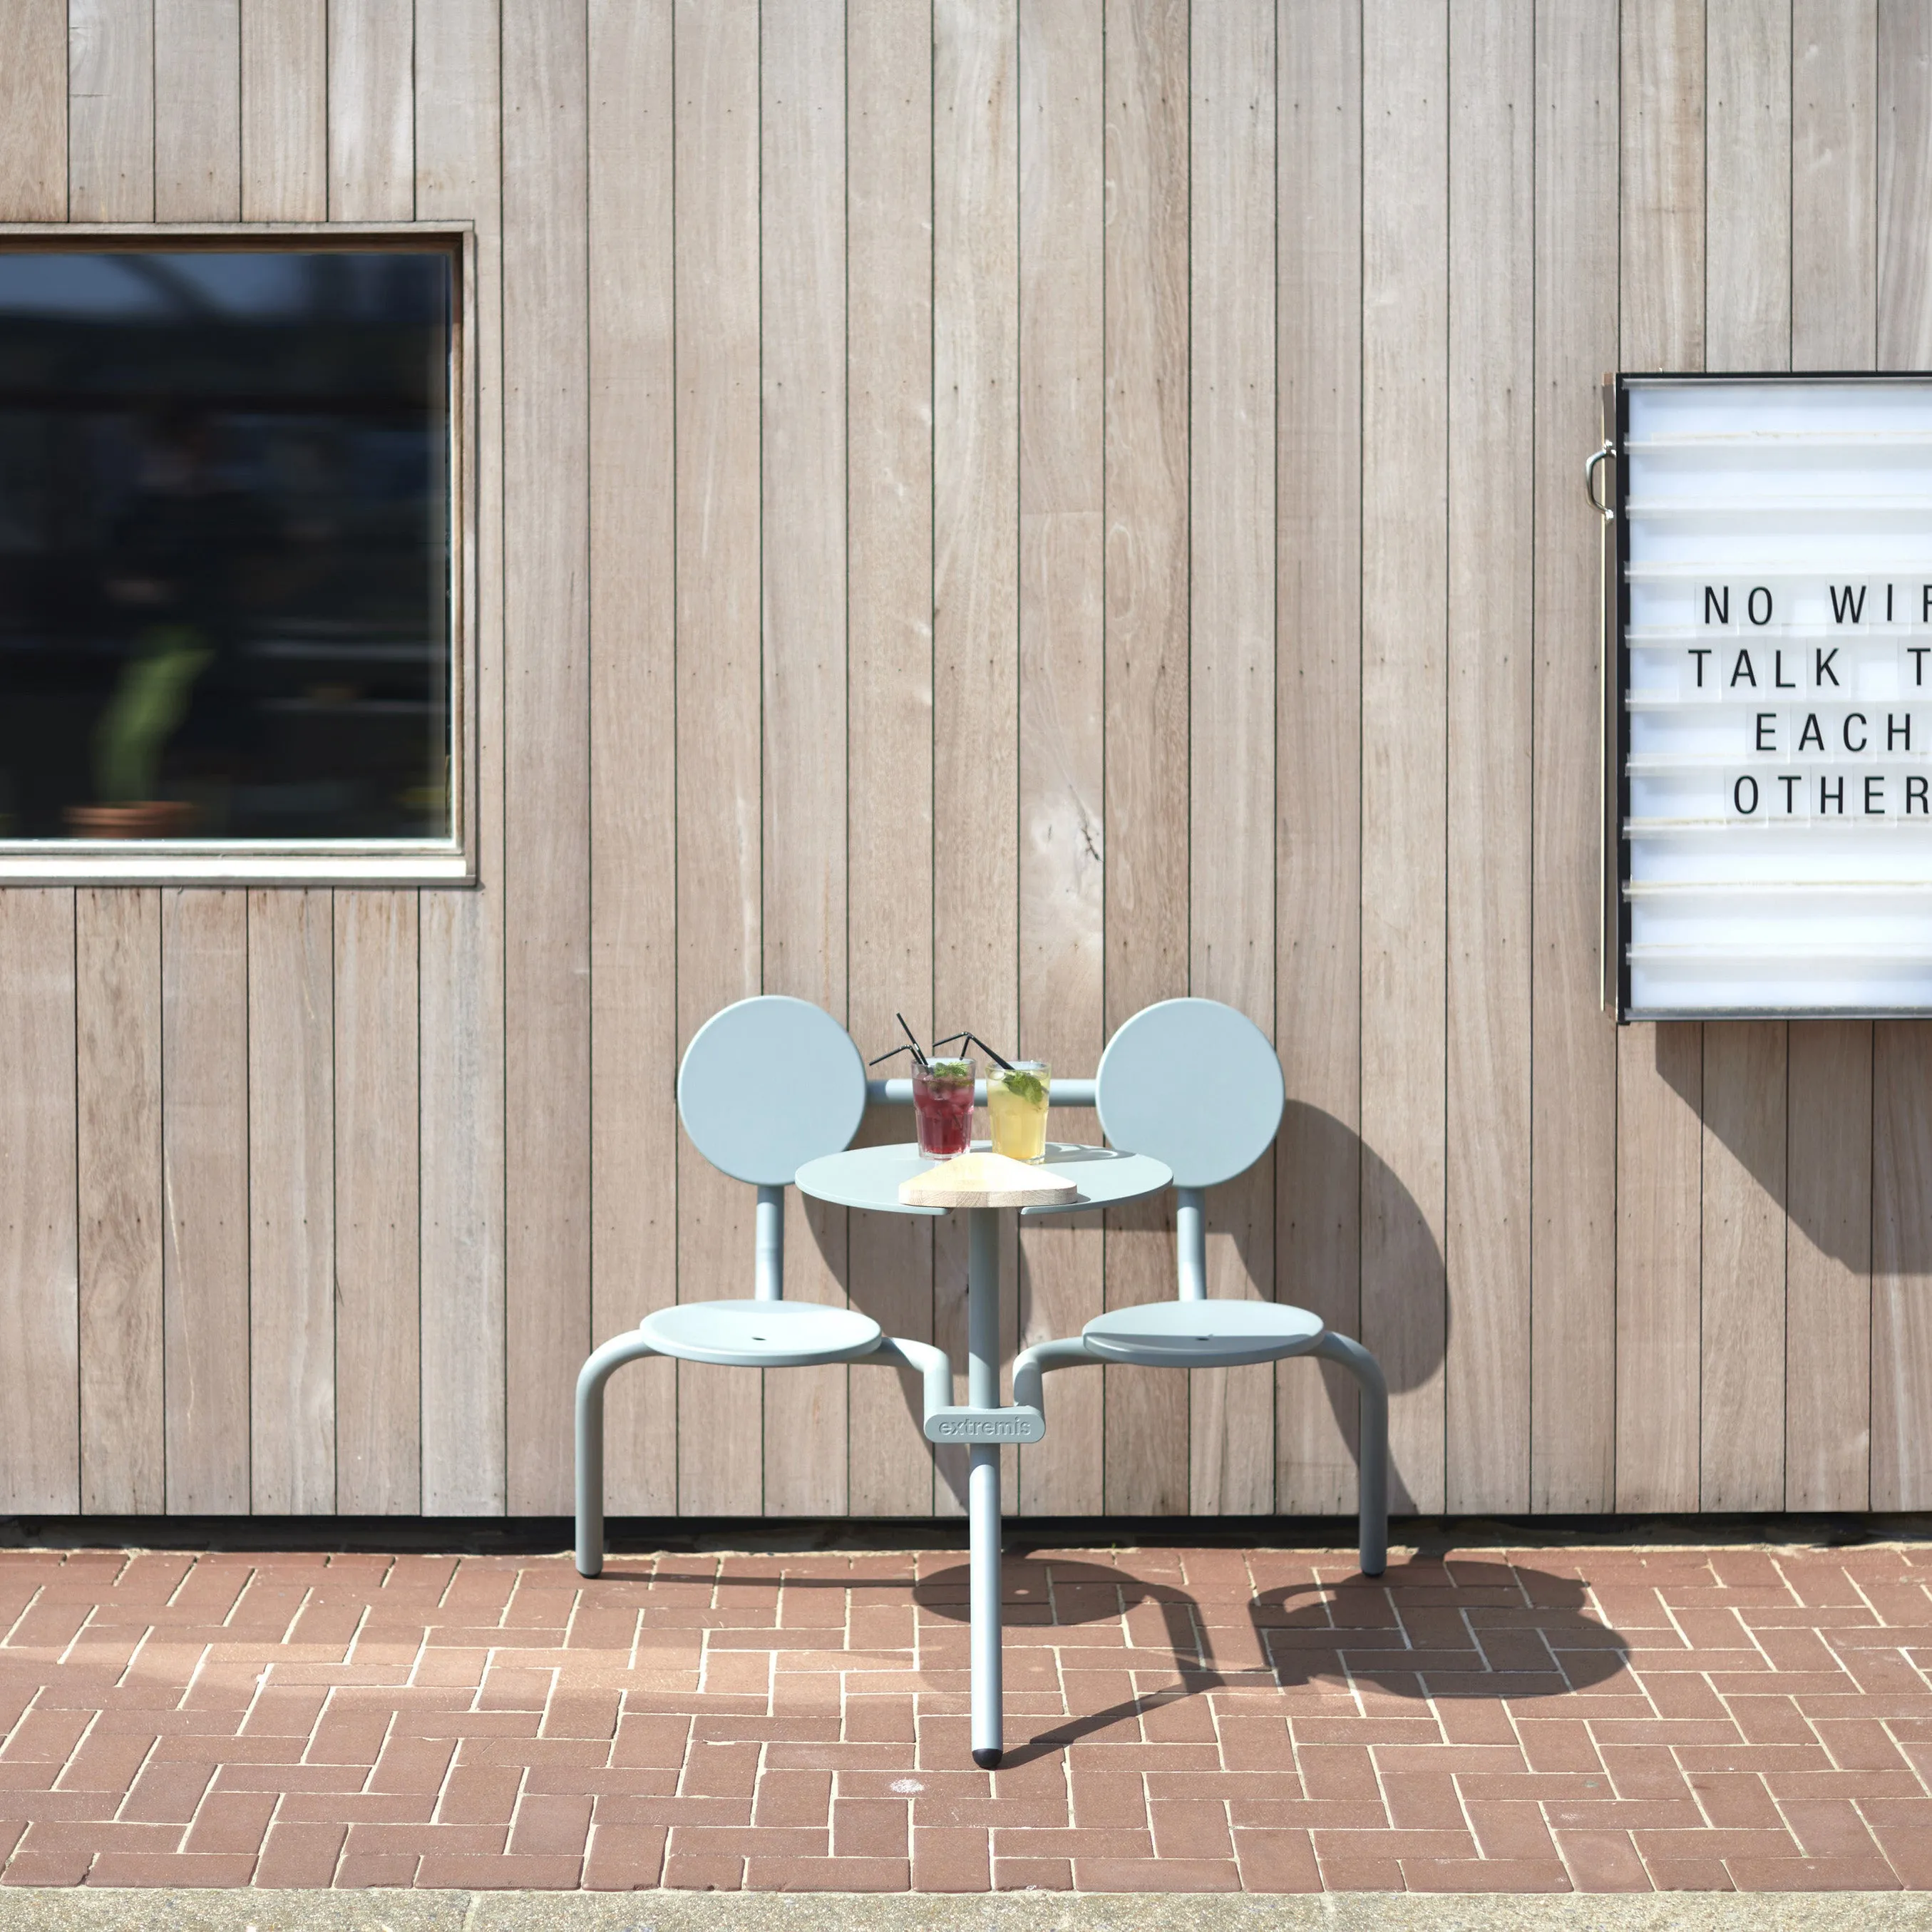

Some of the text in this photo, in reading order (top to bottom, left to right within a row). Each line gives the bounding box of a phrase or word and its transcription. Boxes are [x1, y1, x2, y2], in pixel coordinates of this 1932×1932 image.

[1705, 586, 1773, 625] NO
[1687, 648, 1840, 687] TALK
[1756, 713, 1911, 752] EACH
[1734, 776, 1929, 814] OTHER
[938, 1417, 1032, 1436] extremis
